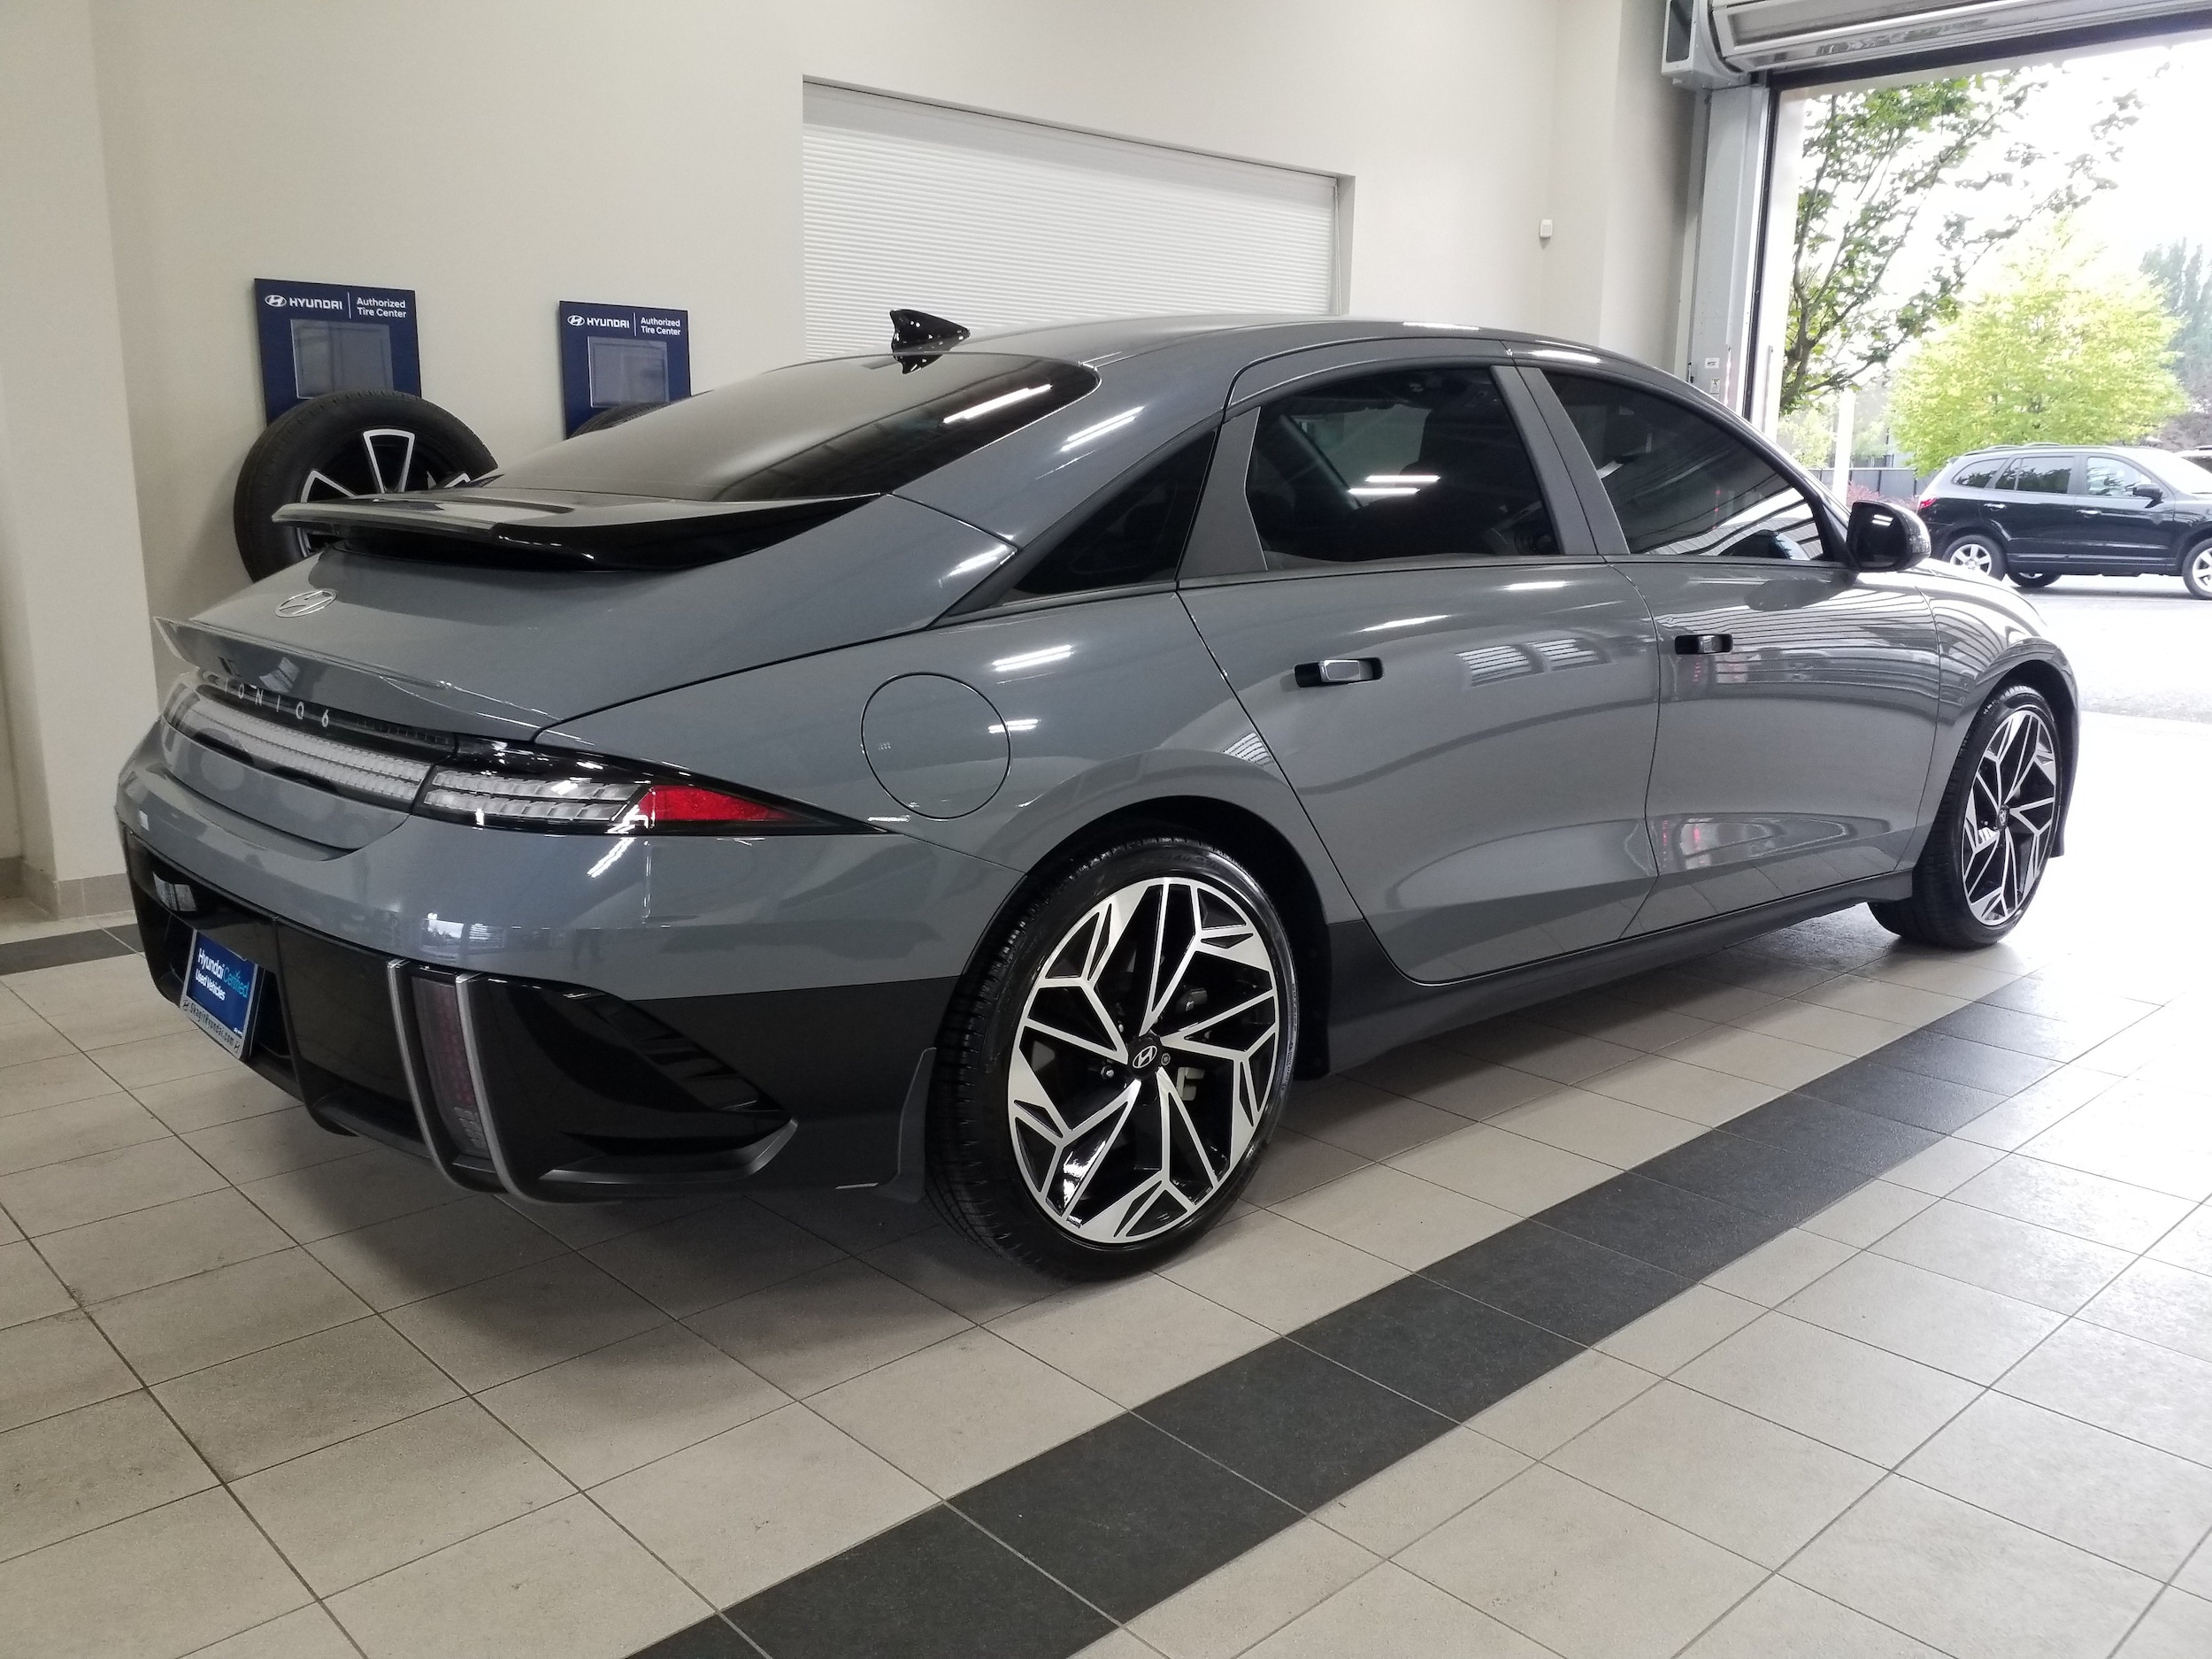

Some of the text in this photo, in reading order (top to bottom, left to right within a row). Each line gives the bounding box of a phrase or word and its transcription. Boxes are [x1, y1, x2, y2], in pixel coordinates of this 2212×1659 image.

[288, 297, 343, 311] HYUNDAI
[356, 296, 407, 309] Authorized
[357, 307, 407, 319] Tire Center
[587, 317, 630, 328] HYUNDAI
[641, 317, 680, 327] Authorized
[641, 325, 681, 336] Tire Center
[197, 947, 225, 980] Hyundai
[195, 968, 227, 1002] Used Vehicles
